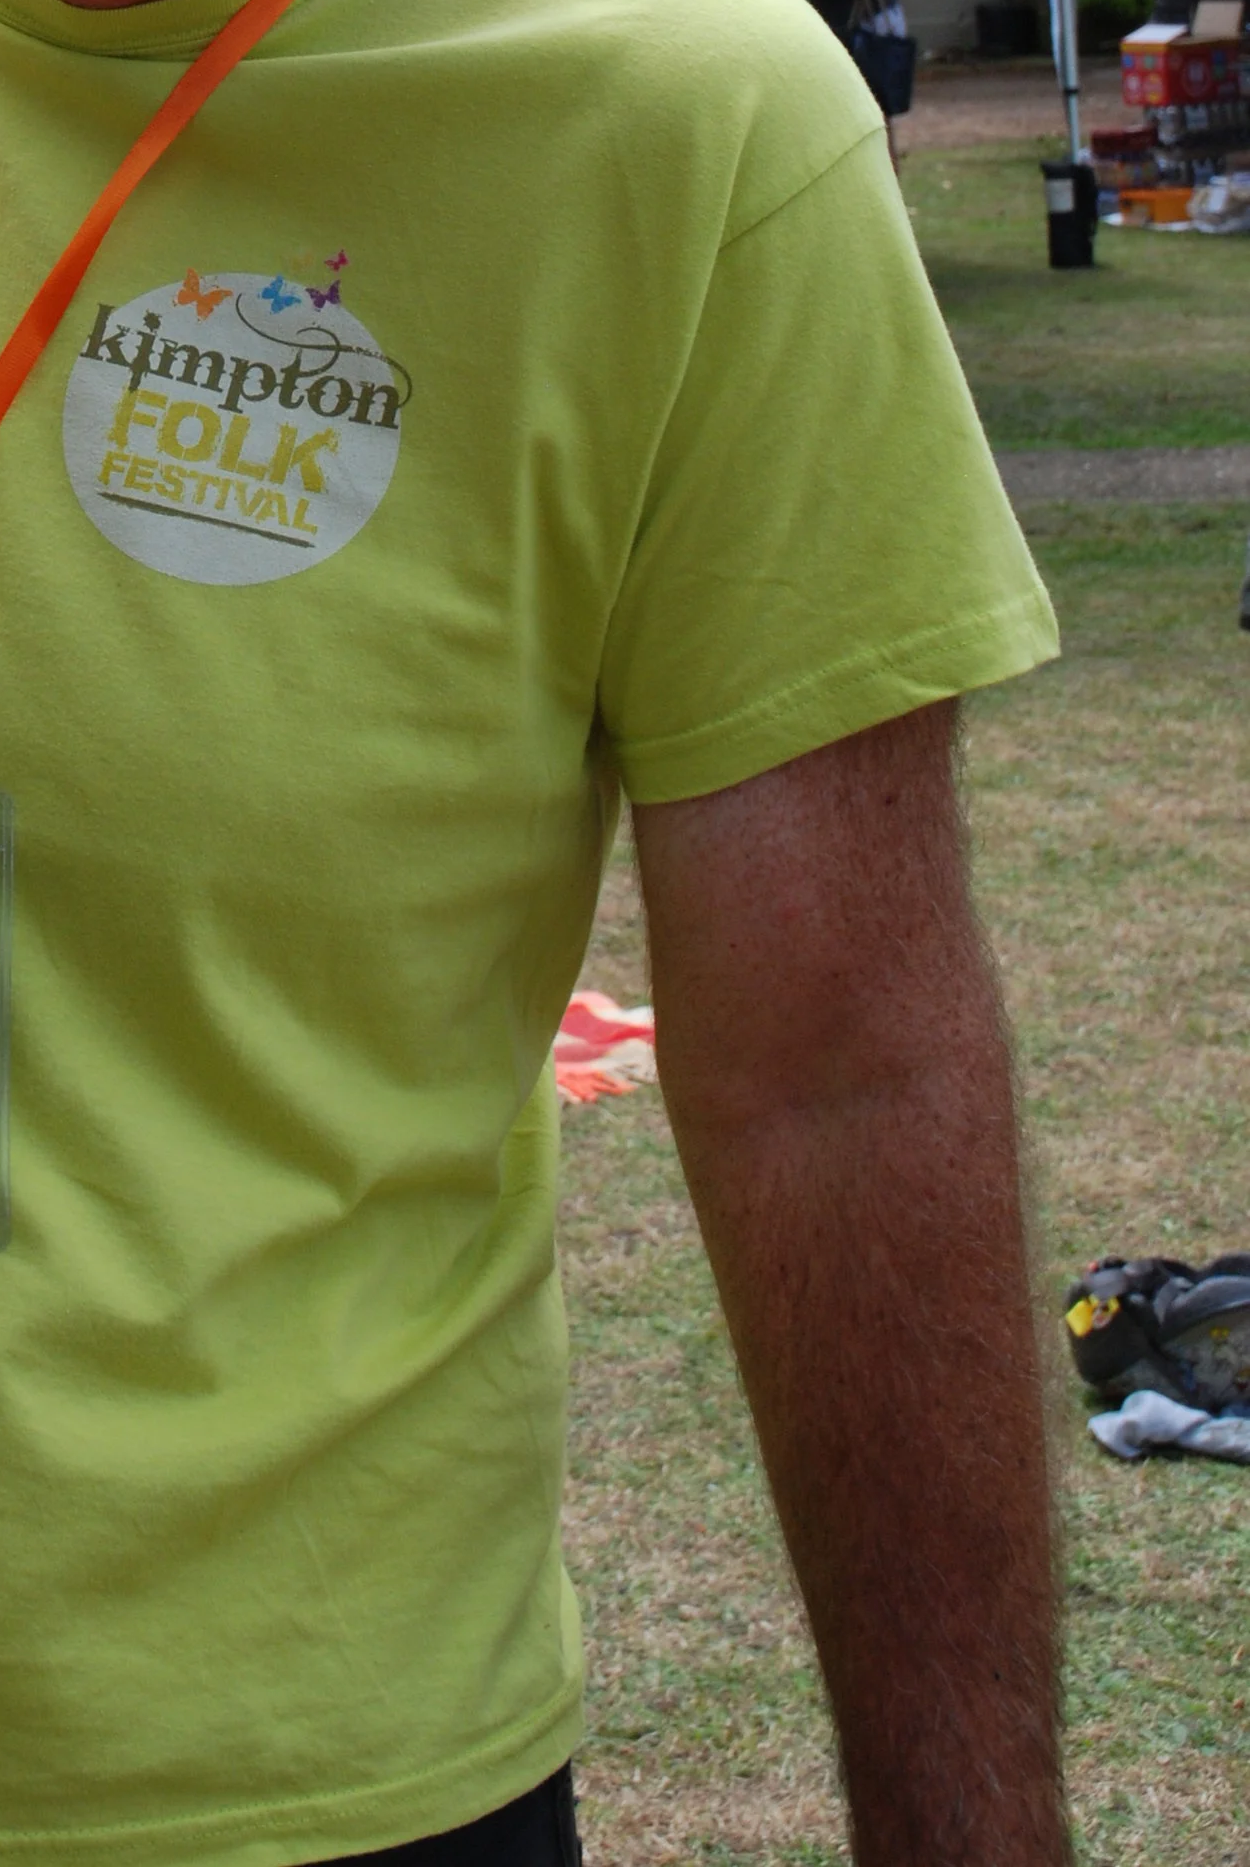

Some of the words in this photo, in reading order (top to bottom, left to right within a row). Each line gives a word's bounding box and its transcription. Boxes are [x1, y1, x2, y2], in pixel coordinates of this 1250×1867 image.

[79, 298, 406, 429] kimpton
[98, 450, 318, 535] FESTIVAL
[108, 387, 340, 493] FOLK
